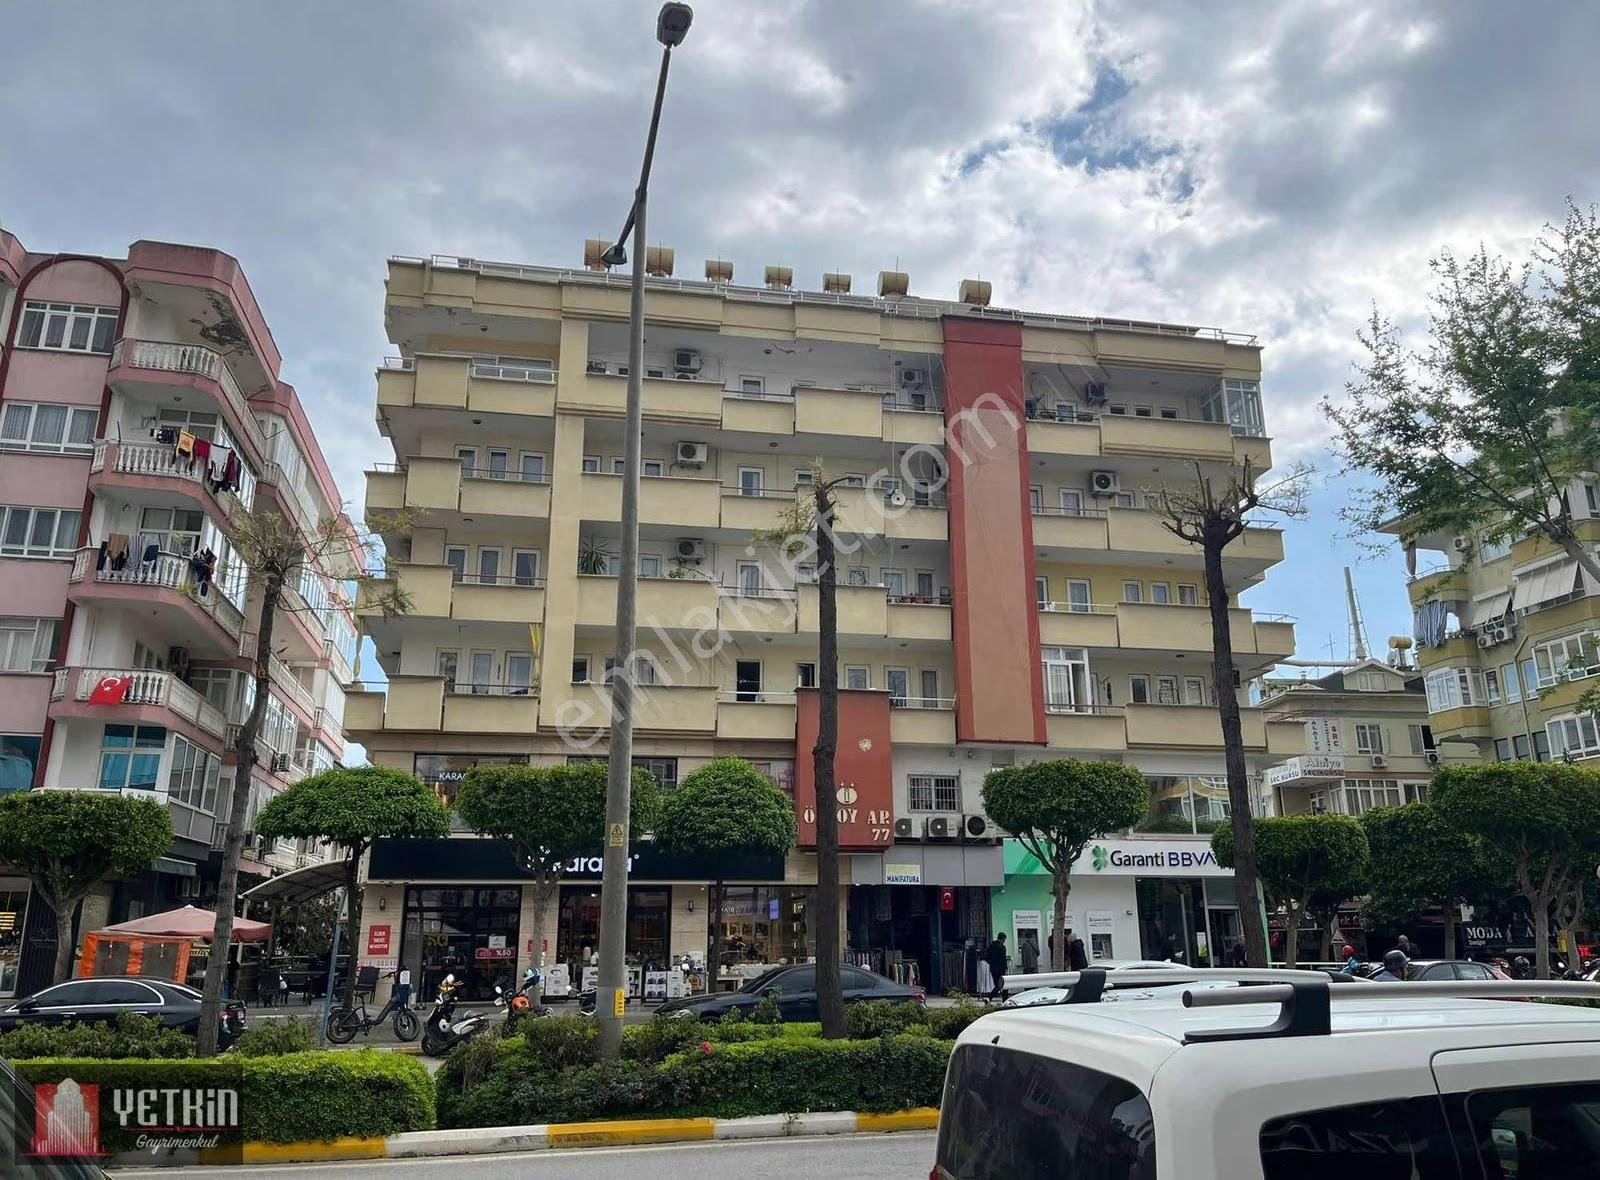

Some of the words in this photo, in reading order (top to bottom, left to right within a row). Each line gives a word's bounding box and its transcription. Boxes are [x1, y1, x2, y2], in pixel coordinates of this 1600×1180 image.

[803, 805, 858, 824] ÖOY
[872, 828, 890, 841] 77
[1110, 850, 1165, 867] Garanti
[1168, 851, 1217, 867] BBVA
[1466, 927, 1503, 939] MODA
